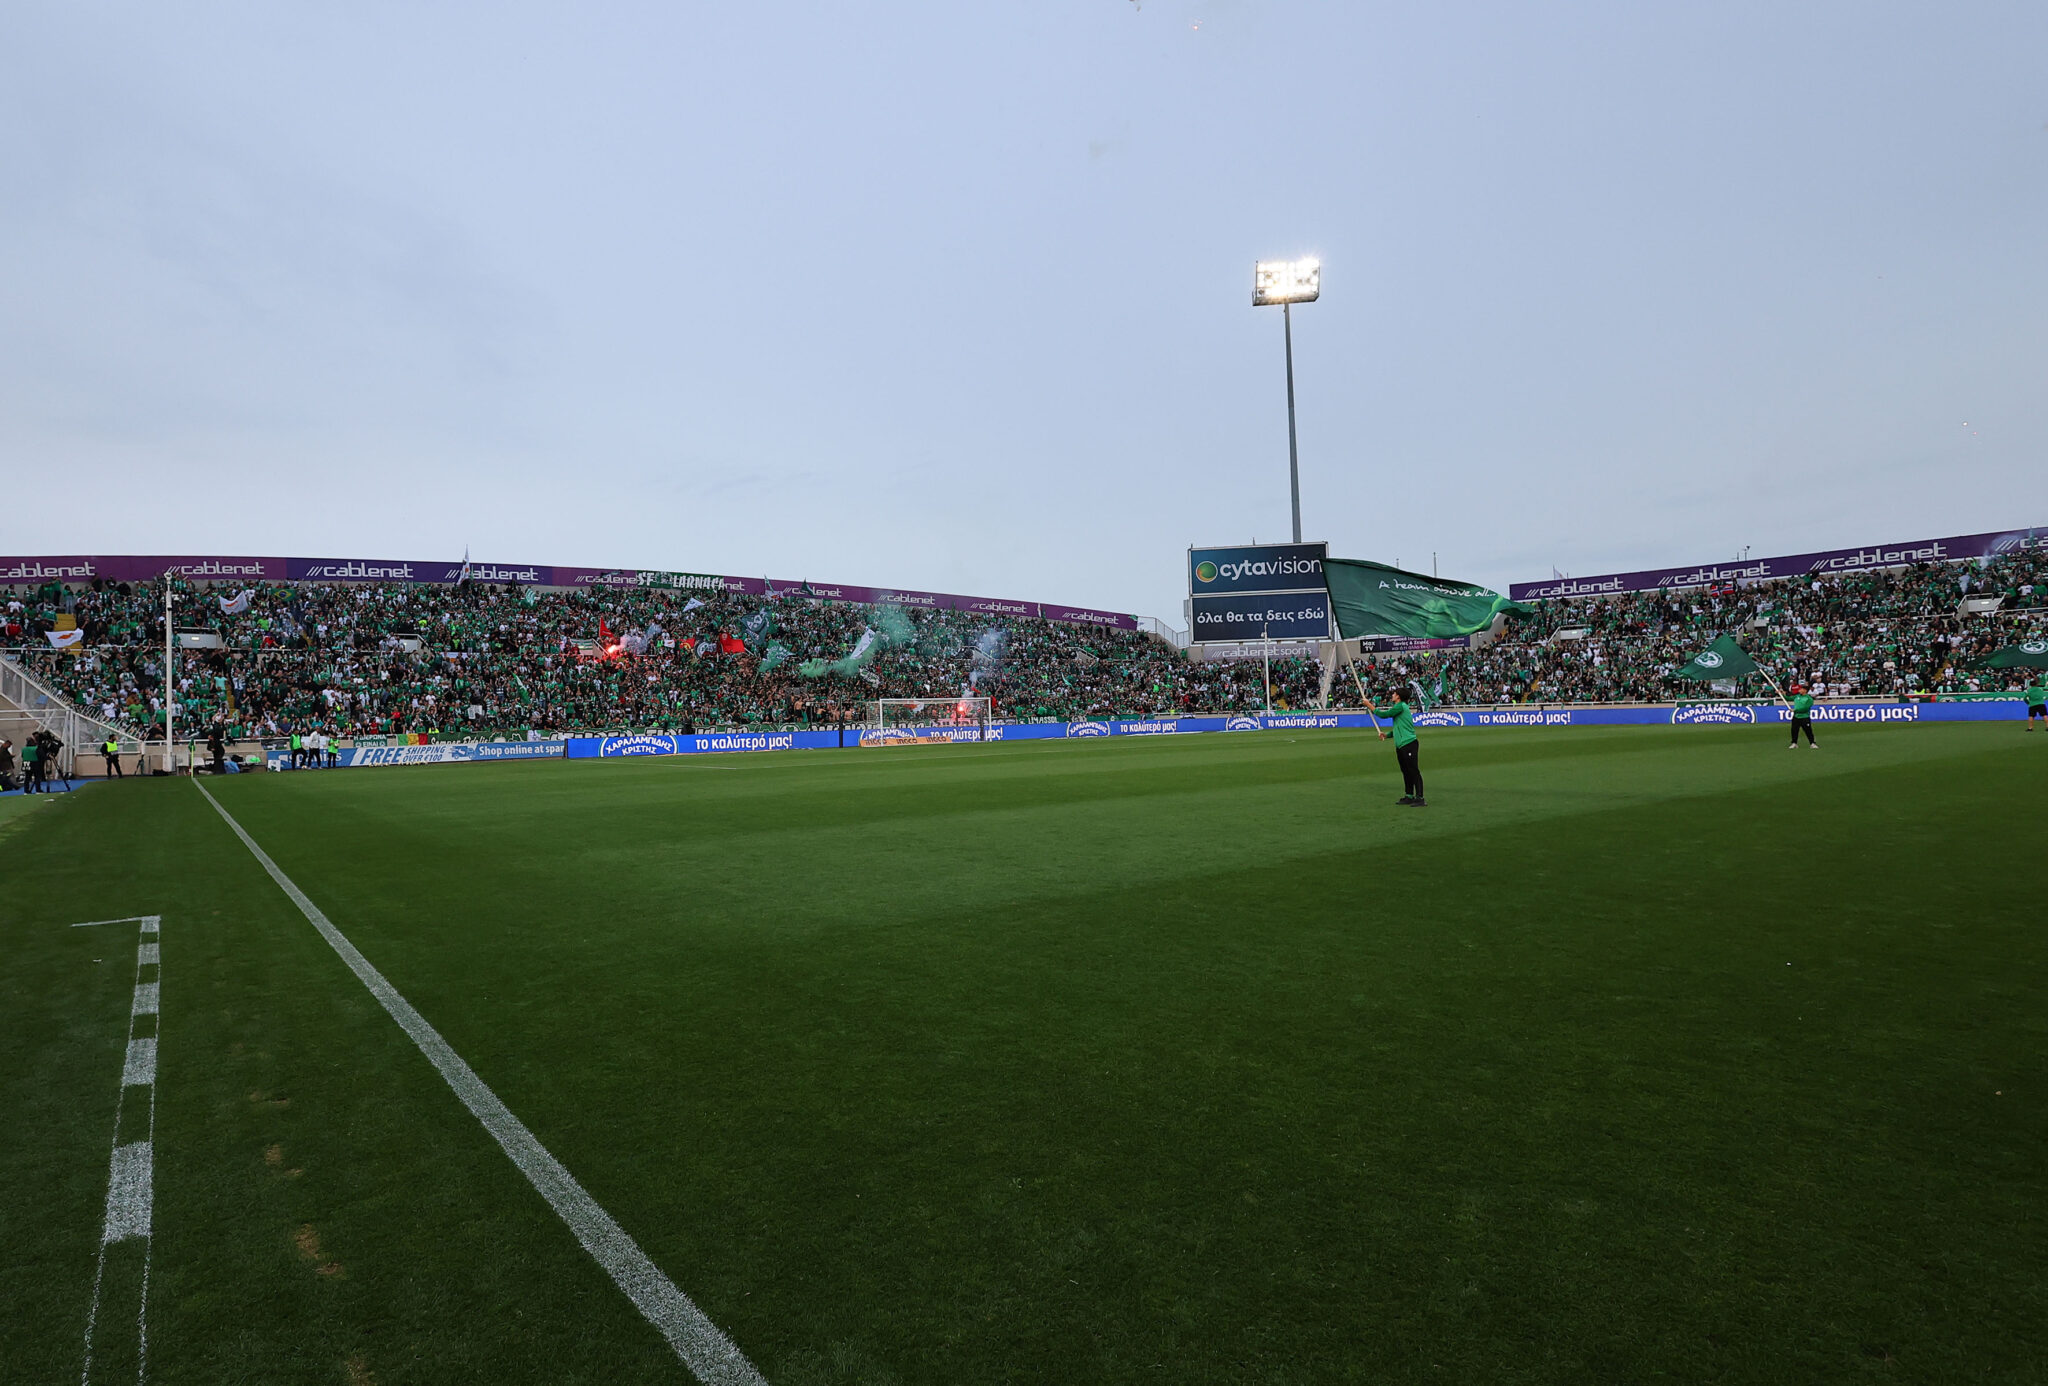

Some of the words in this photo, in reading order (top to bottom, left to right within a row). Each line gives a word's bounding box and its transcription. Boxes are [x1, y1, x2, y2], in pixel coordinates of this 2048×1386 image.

[1829, 542, 1947, 568] cablenet
[181, 561, 265, 575] cablenet
[323, 562, 414, 578] cablenet
[472, 566, 539, 581] ablenet
[1220, 556, 1323, 580] cytavision
[1674, 562, 1771, 585] cablenet
[791, 586, 842, 597] clenet
[1379, 580, 1390, 589] A
[1393, 579, 1430, 591] team
[1539, 577, 1624, 597] cablenet
[887, 593, 936, 605] cablenet
[979, 602, 1028, 614] cablenet
[1071, 611, 1120, 624] cablenet
[1197, 610, 1223, 624] όλα
[1226, 611, 1244, 623] θα
[1247, 612, 1263, 622] τα
[1266, 609, 1295, 623] δεις
[1297, 607, 1325, 620] εδώ
[1222, 646, 1279, 658] cablenet
[1280, 646, 1312, 657] sports
[1479, 715, 1490, 724] το
[1493, 712, 1543, 725] καλύτερό
[1546, 712, 1571, 725] μας!
[1676, 707, 1750, 722] ΧΑΡΑΛΑΜΠΙΔΗΣ
[1693, 715, 1731, 723] ΚΡΙΣΤΗΣ
[1778, 709, 1794, 720] το
[1810, 705, 1875, 721] αλύτερό
[1882, 705, 1918, 721] μας!
[1120, 724, 1128, 732] το
[1130, 721, 1161, 733] καλύτερό
[1162, 721, 1176, 733] μας!
[1275, 716, 1317, 728] καλύτερό
[1320, 716, 1338, 727] μας!
[605, 736, 673, 754] ΧΑΡΑΛΑΜΠΙΔΗΣ
[696, 739, 709, 750] το
[711, 734, 766, 750] καλύτερό
[769, 734, 793, 750] μας!
[360, 748, 405, 764] FREE
[406, 746, 446, 754] SHIPPING
[479, 746, 503, 757] Shop
[504, 744, 533, 755] online
[534, 744, 544, 754] at
[622, 745, 657, 755] ΚΡΙΣΤΗΣ
[403, 754, 423, 762] OVER
[424, 754, 443, 762] €100
